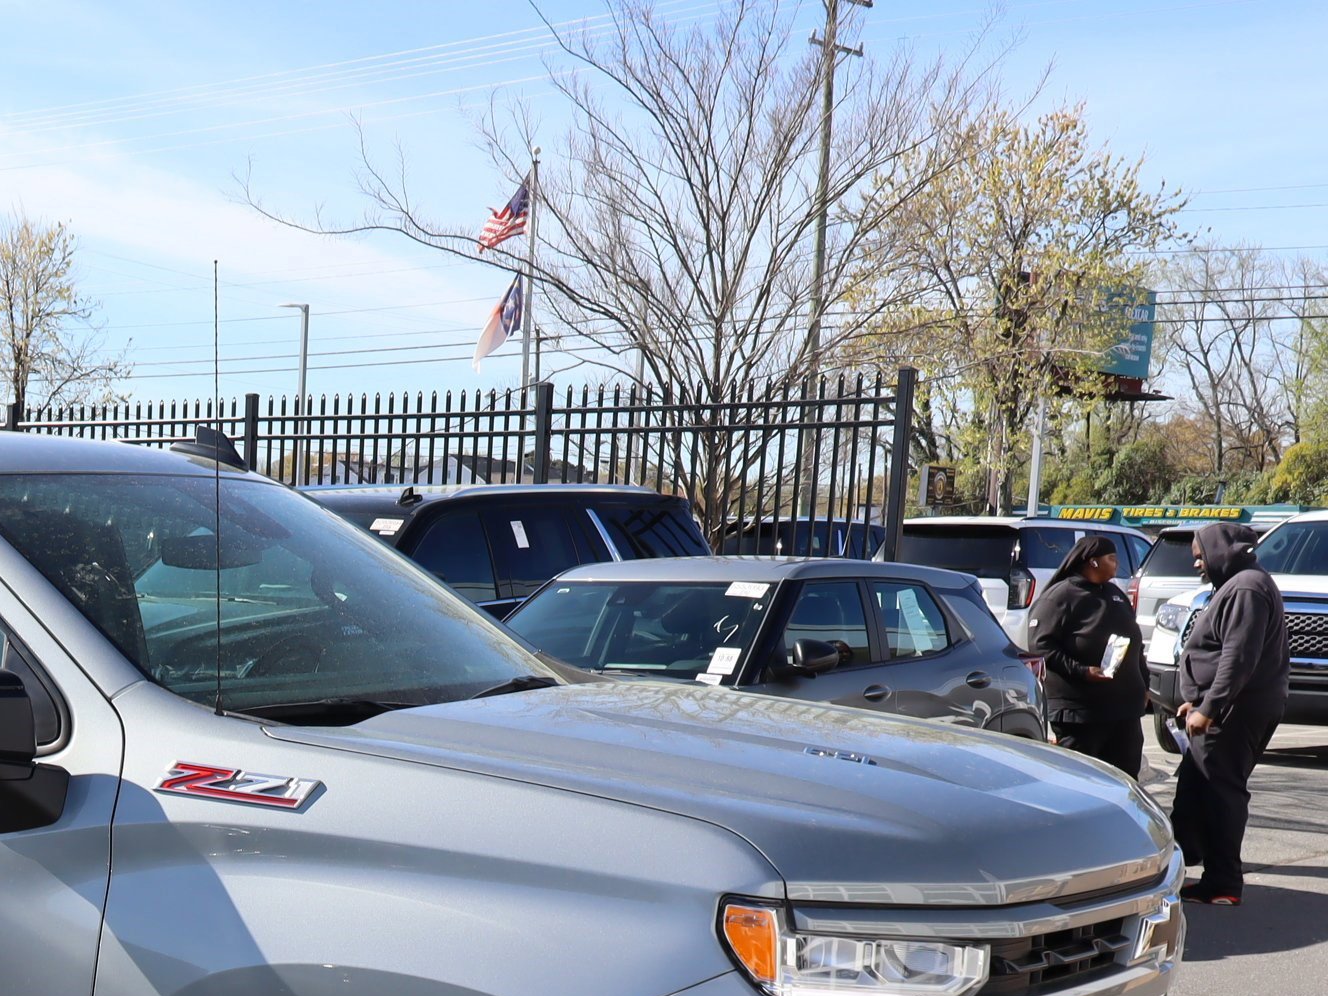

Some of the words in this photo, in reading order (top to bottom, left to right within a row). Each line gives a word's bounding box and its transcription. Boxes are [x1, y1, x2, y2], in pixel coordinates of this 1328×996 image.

[1058, 507, 1113, 520] MAVIS
[1121, 507, 1164, 518] TIRES
[1178, 507, 1242, 518] BRAKES
[151, 759, 322, 809] Z71
